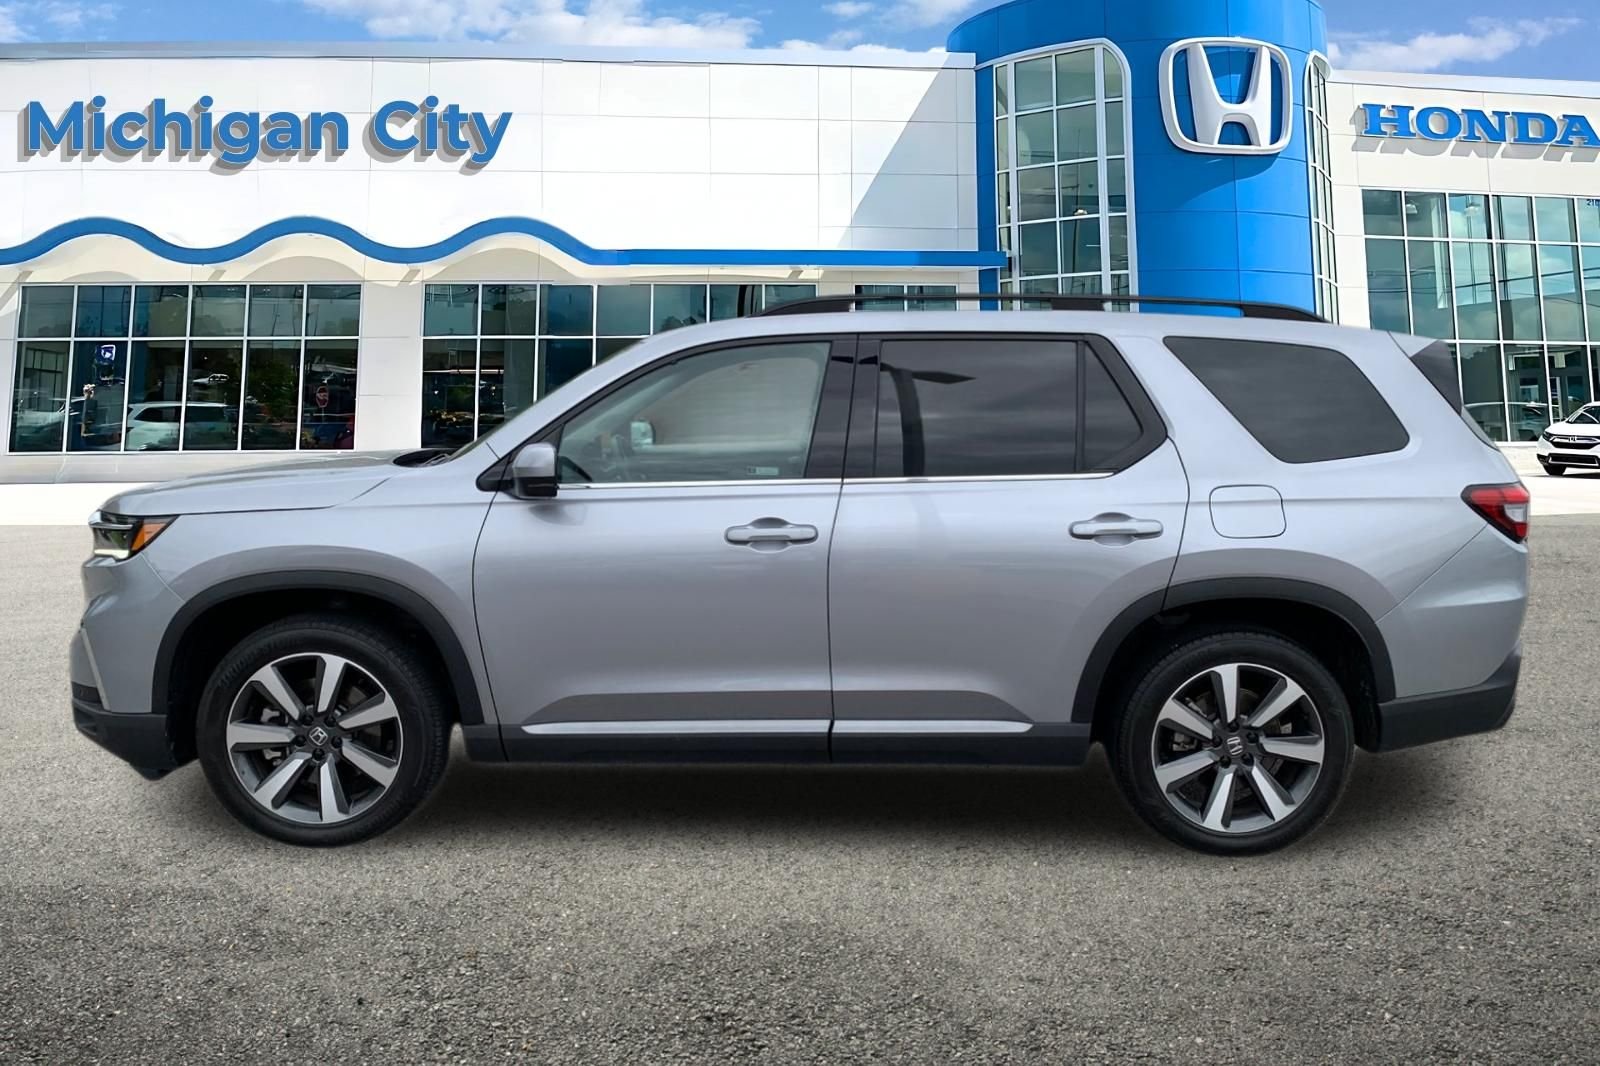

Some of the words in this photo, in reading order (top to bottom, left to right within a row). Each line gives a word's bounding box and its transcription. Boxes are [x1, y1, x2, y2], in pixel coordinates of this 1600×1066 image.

[29, 95, 349, 164] Michigan
[374, 95, 513, 164] City
[1361, 103, 1600, 147] HONDA
